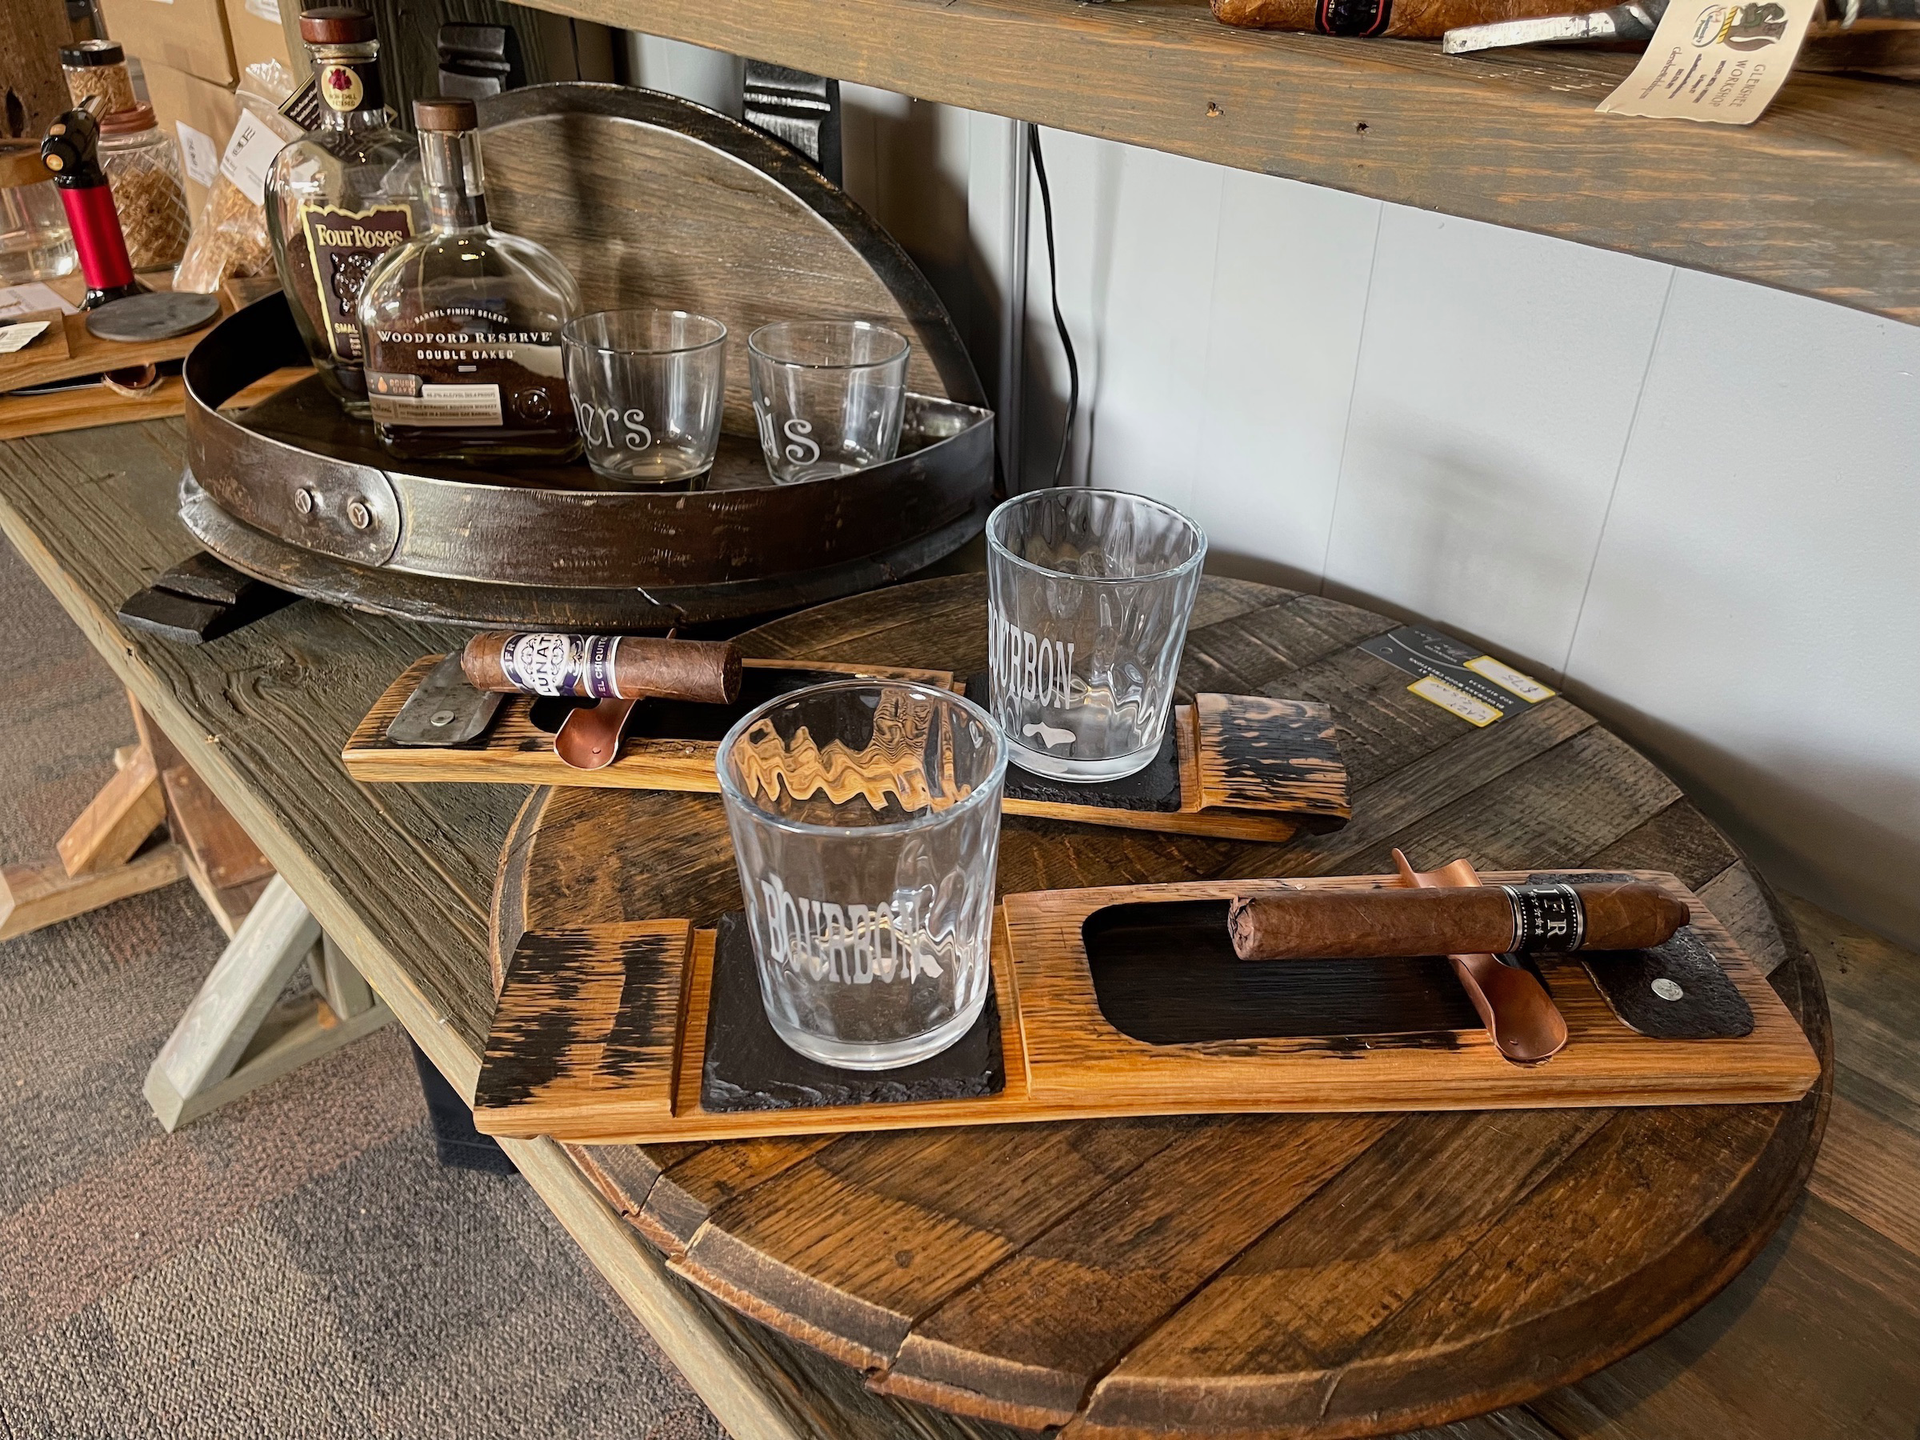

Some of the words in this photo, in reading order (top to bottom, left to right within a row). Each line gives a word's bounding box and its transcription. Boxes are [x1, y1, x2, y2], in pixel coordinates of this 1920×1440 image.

[1709, 59, 1749, 108] WORKSHOP
[1728, 63, 1766, 108] GLENSHEE
[316, 224, 351, 246] Four
[351, 226, 403, 249] Roses
[334, 322, 358, 334] SMAL
[414, 309, 445, 324] BARREL
[446, 308, 475, 316] FINISH
[477, 309, 509, 324] SELECT
[377, 330, 469, 344] WOODFORD
[475, 331, 552, 344] RESERVE
[417, 349, 467, 360] DOUBLE
[472, 350, 514, 360] OAKED
[504, 639, 517, 674] JFR
[594, 636, 608, 679] CHIQUITO
[988, 598, 1075, 710] OURBON
[598, 681, 606, 692] EL
[761, 878, 922, 985] BOURBON
